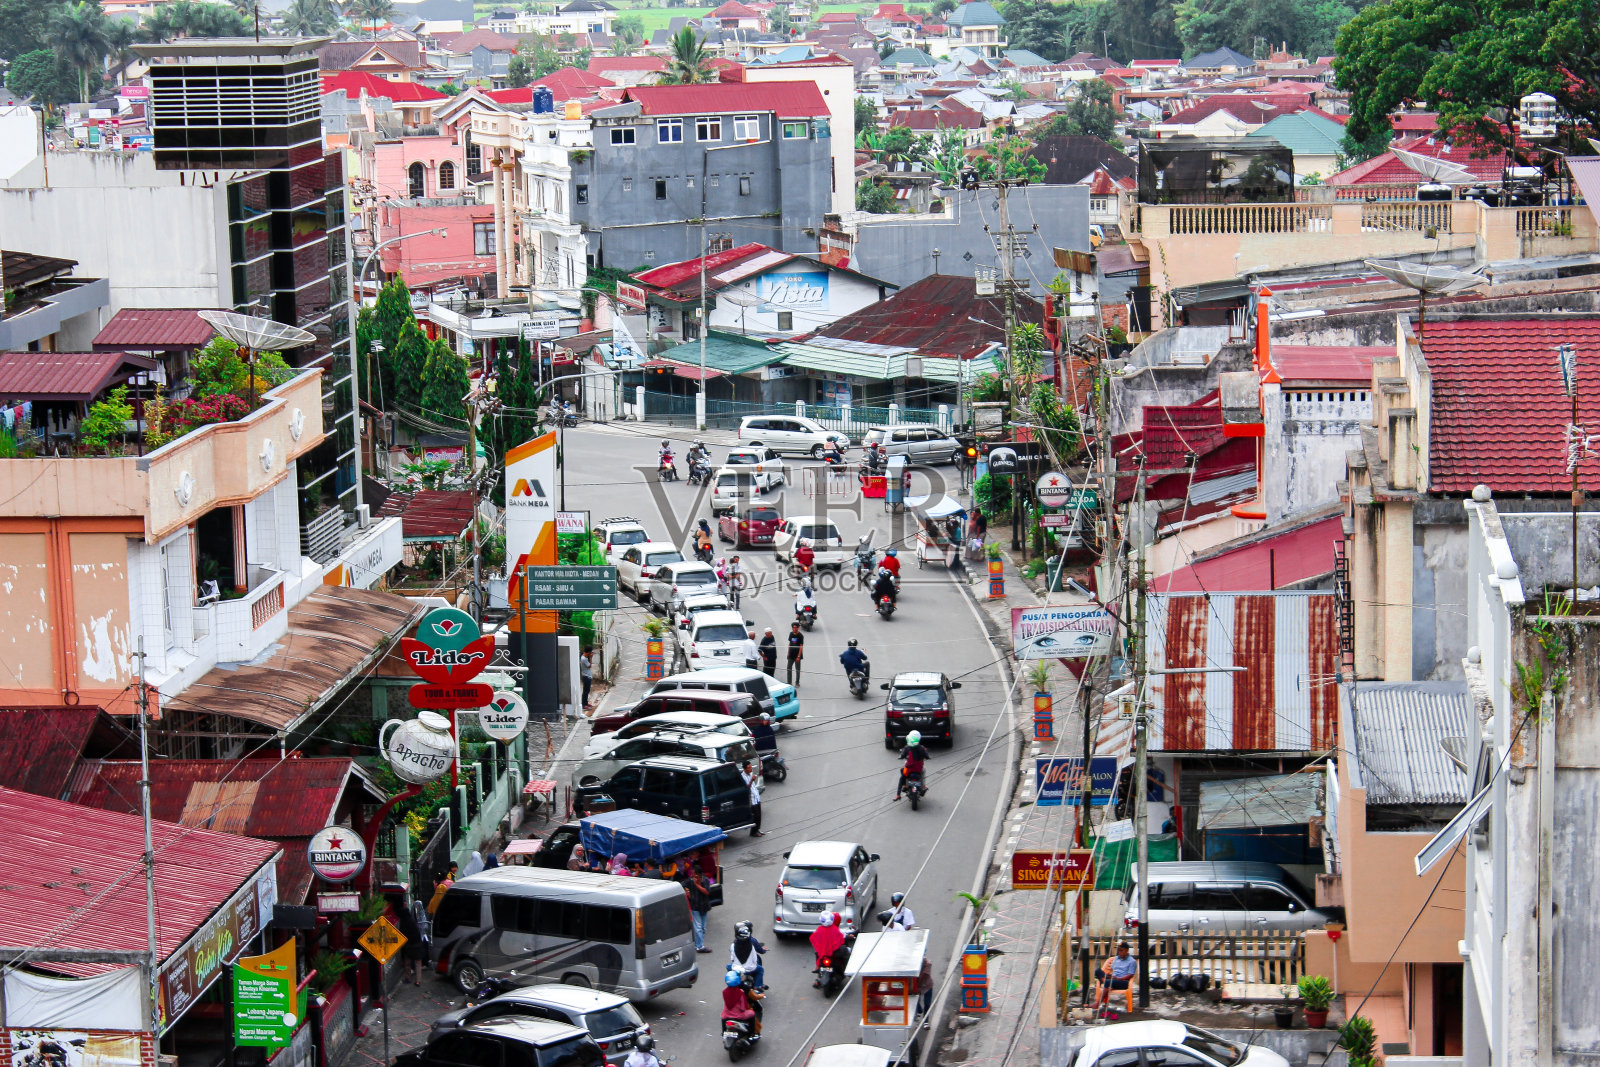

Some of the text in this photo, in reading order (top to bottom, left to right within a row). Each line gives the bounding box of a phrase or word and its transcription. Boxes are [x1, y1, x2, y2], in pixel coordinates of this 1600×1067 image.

[761, 276, 824, 304] Vista
[368, 547, 382, 570] MEGA
[1051, 610, 1108, 620] PENGOBATAN
[1020, 620, 1082, 639] TRADISIONAL
[411, 648, 485, 666] Lido
[424, 689, 443, 697] TOUR
[453, 689, 479, 697] TRAVEL
[484, 714, 522, 722] Lido
[396, 744, 445, 770] apache
[314, 852, 357, 862] BINTANG
[322, 898, 356, 909] APACHE
